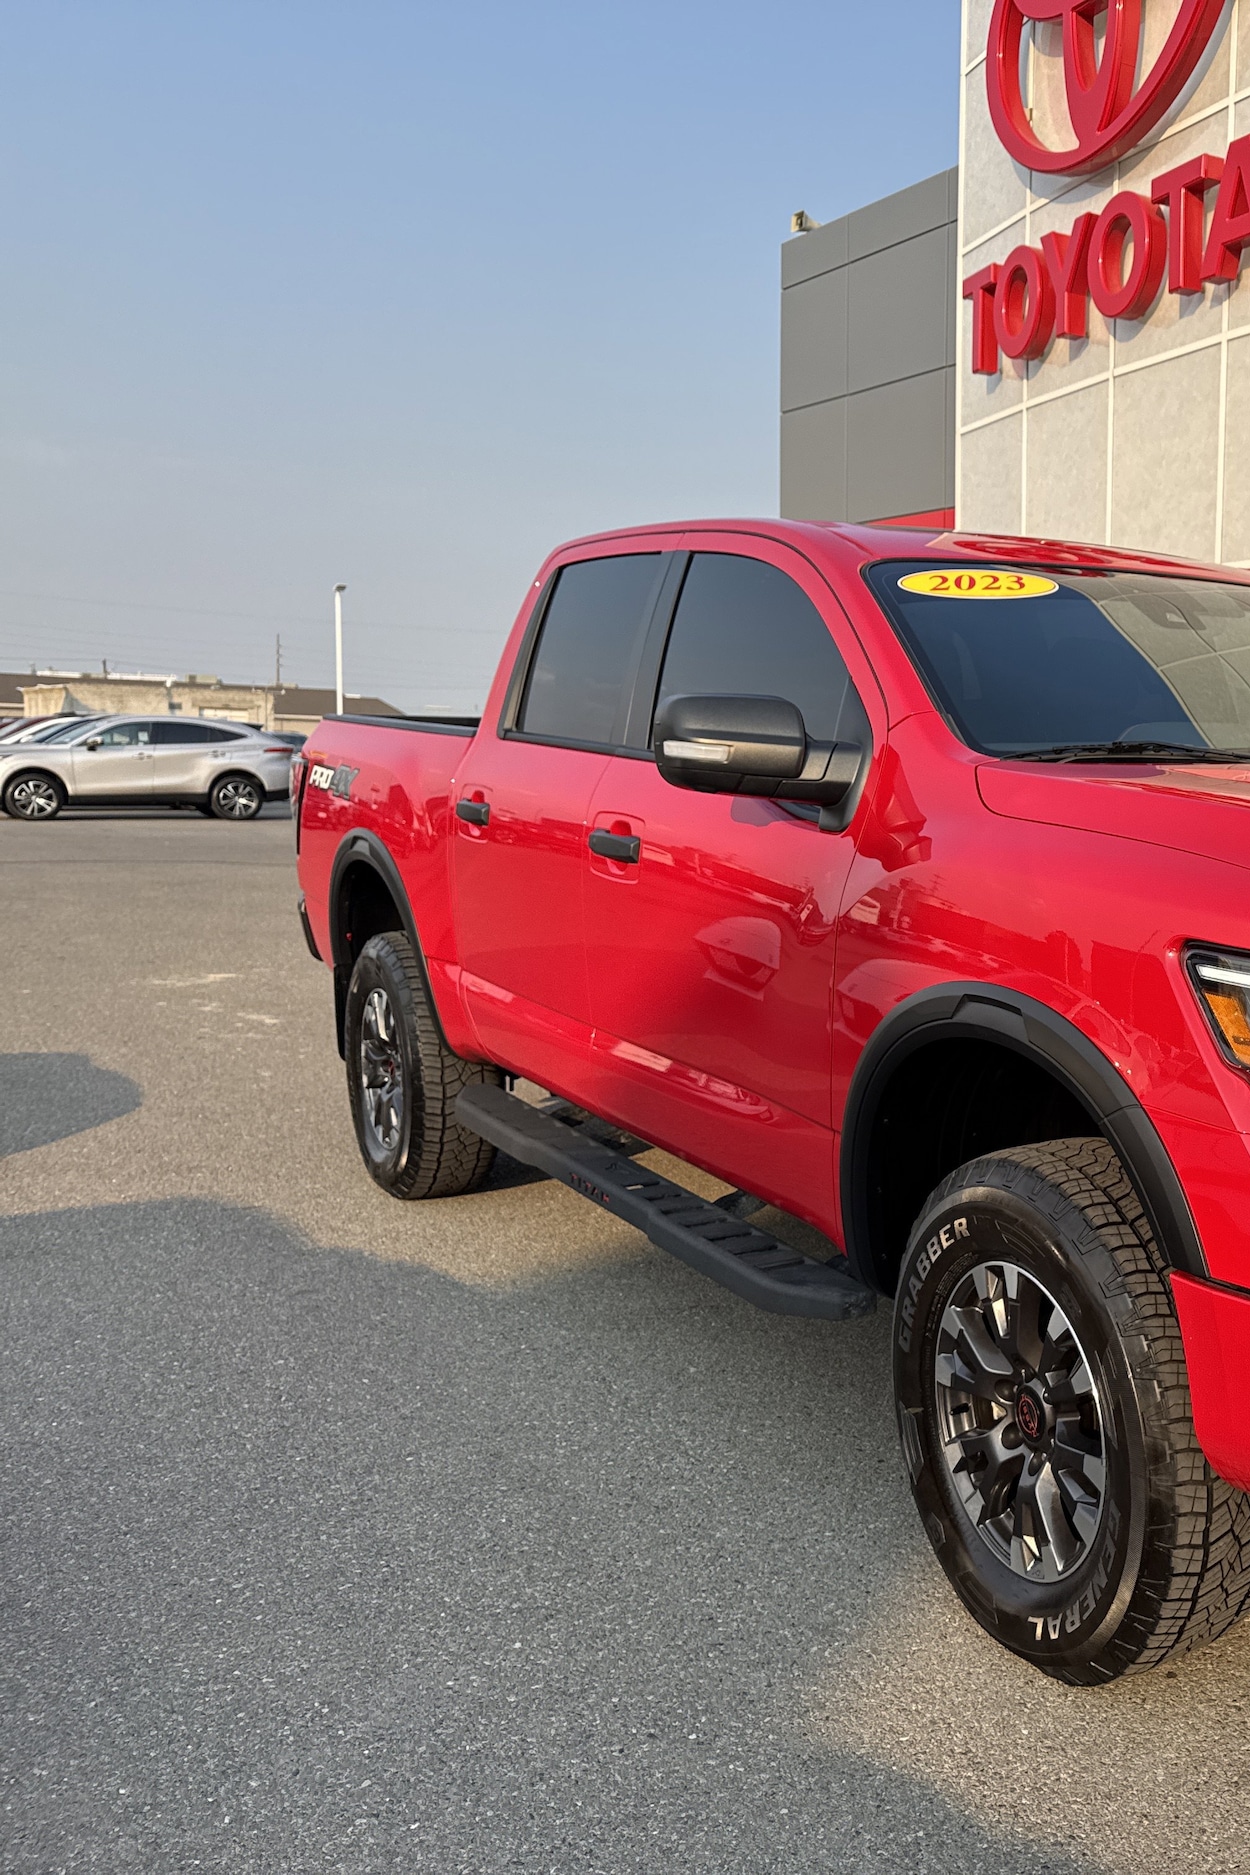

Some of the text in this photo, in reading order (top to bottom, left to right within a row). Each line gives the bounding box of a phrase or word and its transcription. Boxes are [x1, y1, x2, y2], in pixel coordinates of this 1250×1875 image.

[929, 574, 1026, 591] 2023
[898, 1217, 971, 1353] GRABBER
[1027, 1499, 1121, 1641] GENERAL
